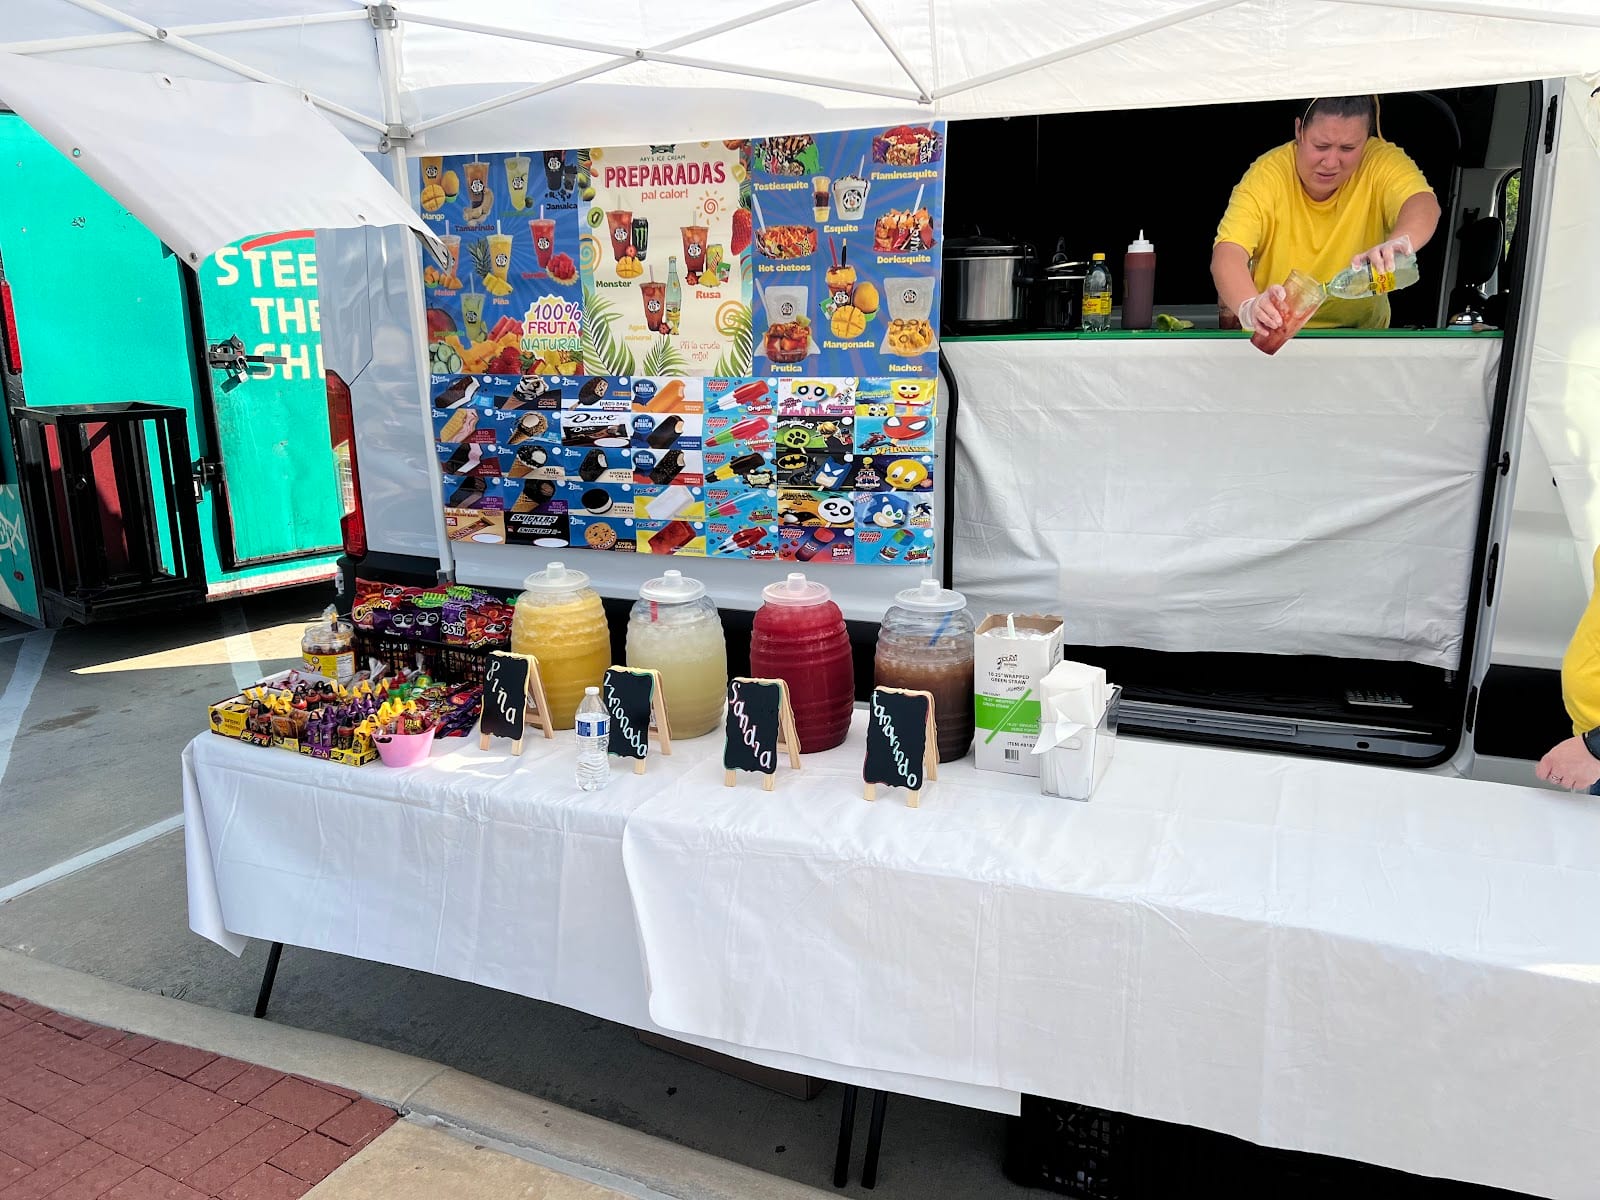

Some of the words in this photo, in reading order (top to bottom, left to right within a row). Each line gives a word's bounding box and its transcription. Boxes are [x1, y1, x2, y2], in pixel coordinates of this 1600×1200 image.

[604, 161, 726, 188] PREPARADAS
[641, 189, 657, 203] pal
[659, 188, 689, 200] calor!
[545, 201, 578, 211] Jamaica
[422, 212, 445, 222] Mango
[454, 224, 495, 233] Tamarindo
[758, 263, 775, 272] Hot
[596, 280, 632, 288] Monster
[695, 290, 721, 300] Rusa
[533, 301, 582, 321] 100%
[528, 321, 578, 335] FRUTA
[521, 338, 583, 352] NATURAL
[823, 340, 875, 351] Mangonada
[889, 364, 923, 373] Nachos
[510, 514, 558, 524] SNICKERS
